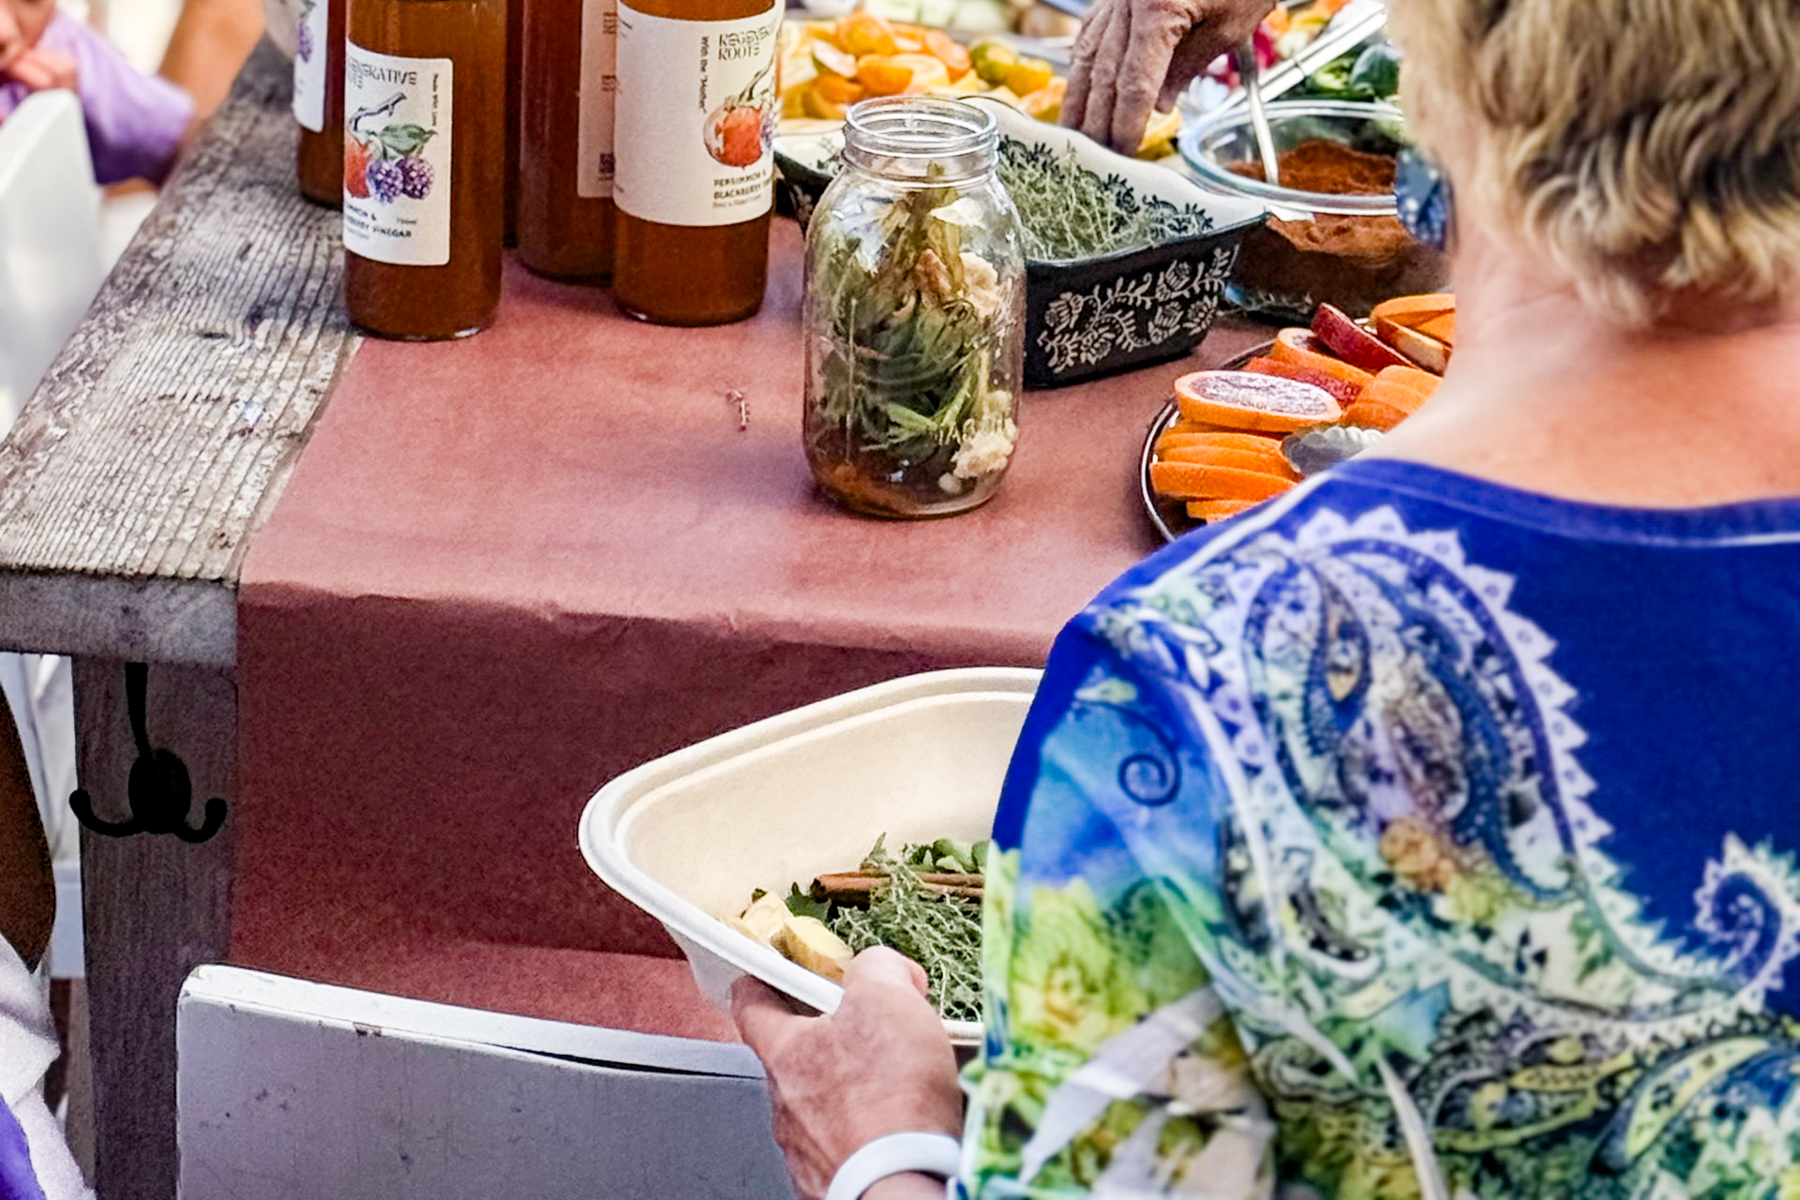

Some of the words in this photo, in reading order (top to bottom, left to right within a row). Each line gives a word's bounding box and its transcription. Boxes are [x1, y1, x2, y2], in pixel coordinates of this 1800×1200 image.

[701, 36, 709, 57] With
[718, 46, 760, 61] ROOTS
[700, 59, 708, 73] the
[372, 227, 412, 239] VINEGAR
